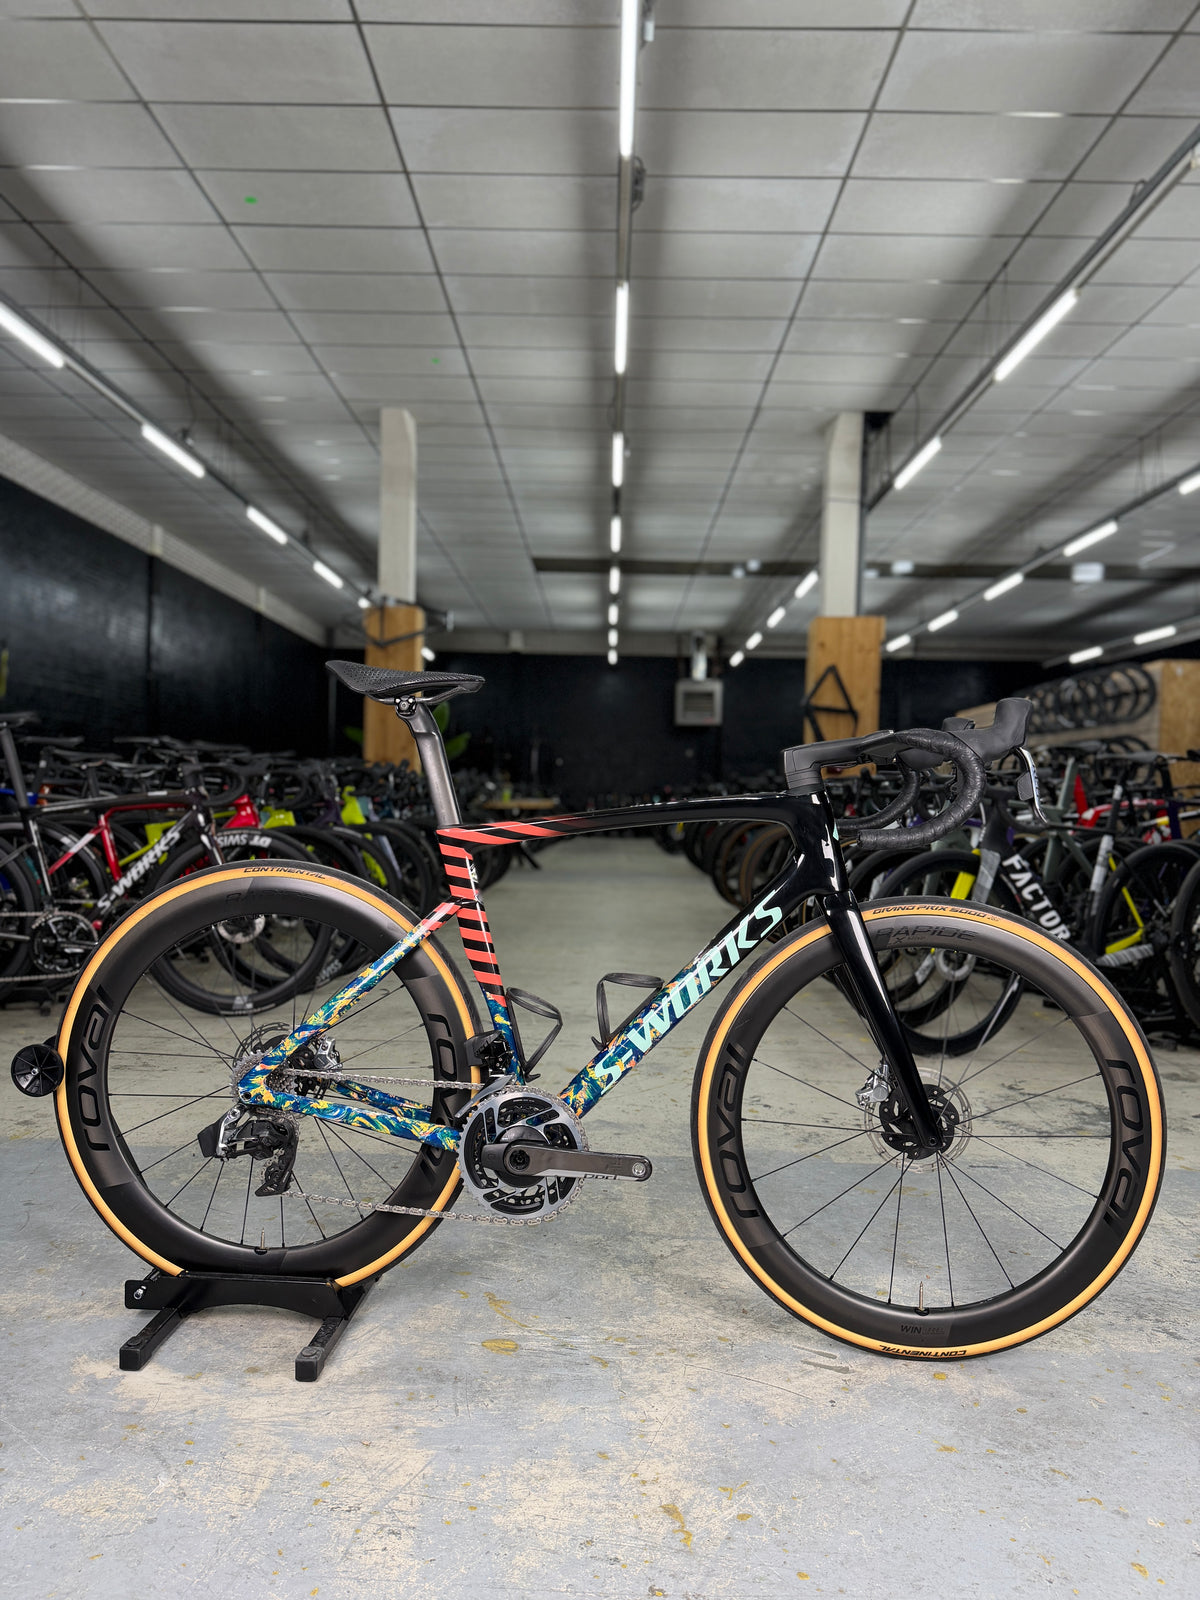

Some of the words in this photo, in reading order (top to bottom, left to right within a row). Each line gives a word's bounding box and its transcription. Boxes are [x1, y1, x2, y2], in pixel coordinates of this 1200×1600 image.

[249, 836, 272, 848] DT
[97, 823, 185, 915] S-WORKS
[244, 867, 326, 879] CONTINENTAL
[1001, 853, 1071, 940] FACTOR
[872, 905, 917, 915] GRAND
[917, 904, 948, 912] PRIX
[949, 907, 988, 918] 5000
[875, 925, 978, 941] RAPIDE
[594, 890, 783, 1095] S-WORKS
[879, 1344, 967, 1358] CONTINENTAL
